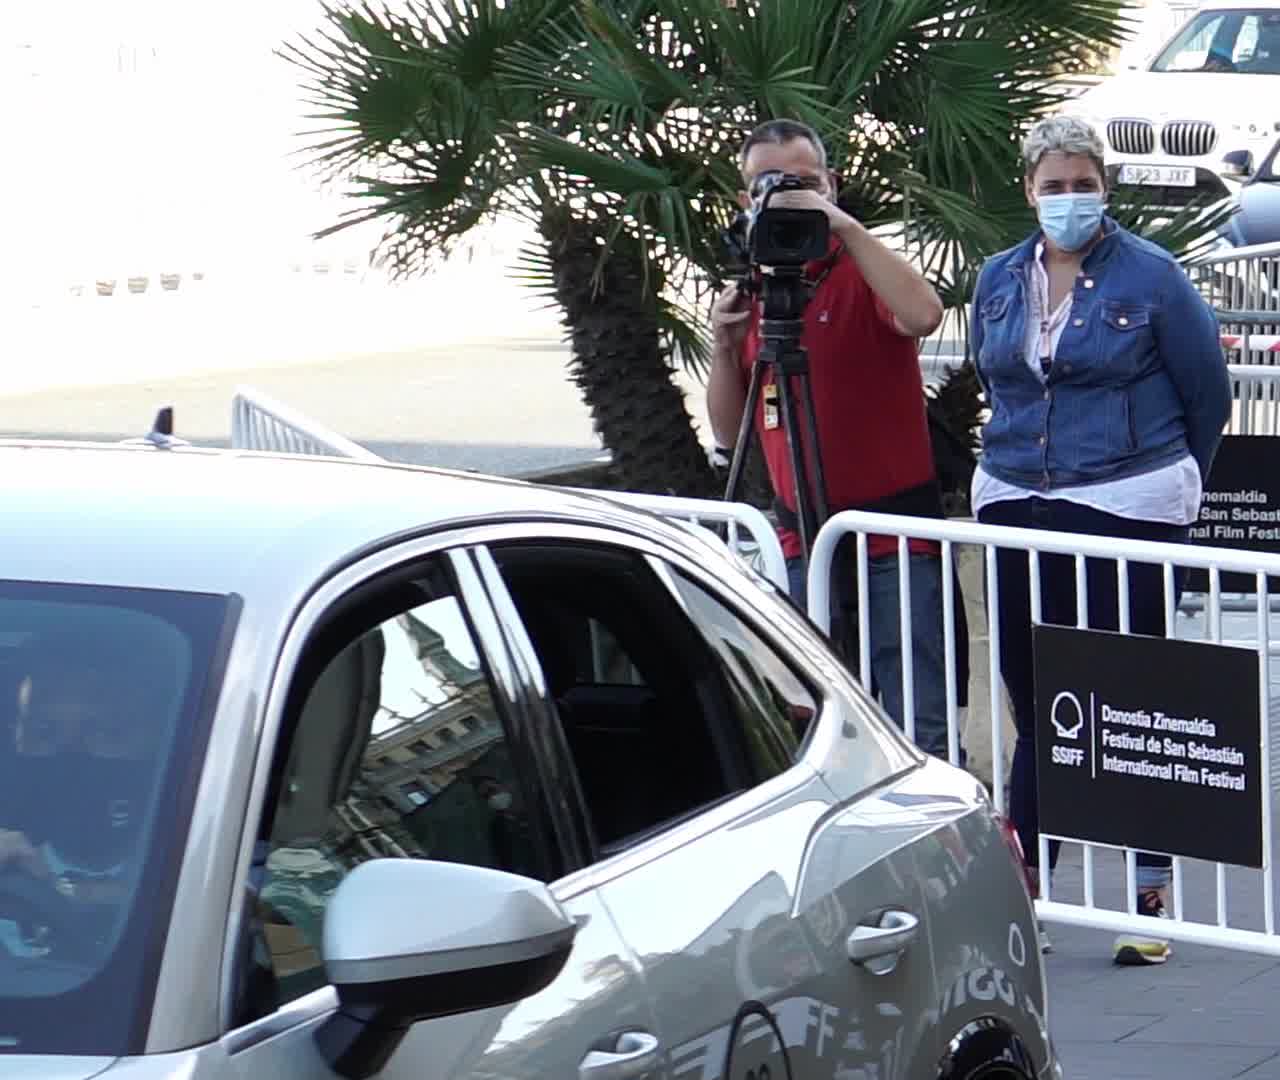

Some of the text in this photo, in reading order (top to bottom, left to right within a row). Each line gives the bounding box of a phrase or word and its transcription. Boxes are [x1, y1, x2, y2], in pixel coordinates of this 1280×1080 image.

[1201, 507, 1229, 522] San
[1214, 525, 1245, 540] Film
[1102, 704, 1216, 737] Donostia Zinemaldia
[1052, 745, 1085, 767] SSIFF
[1102, 729, 1244, 766] Festival de San Sebastián
[1103, 753, 1245, 791] International Film Festival
